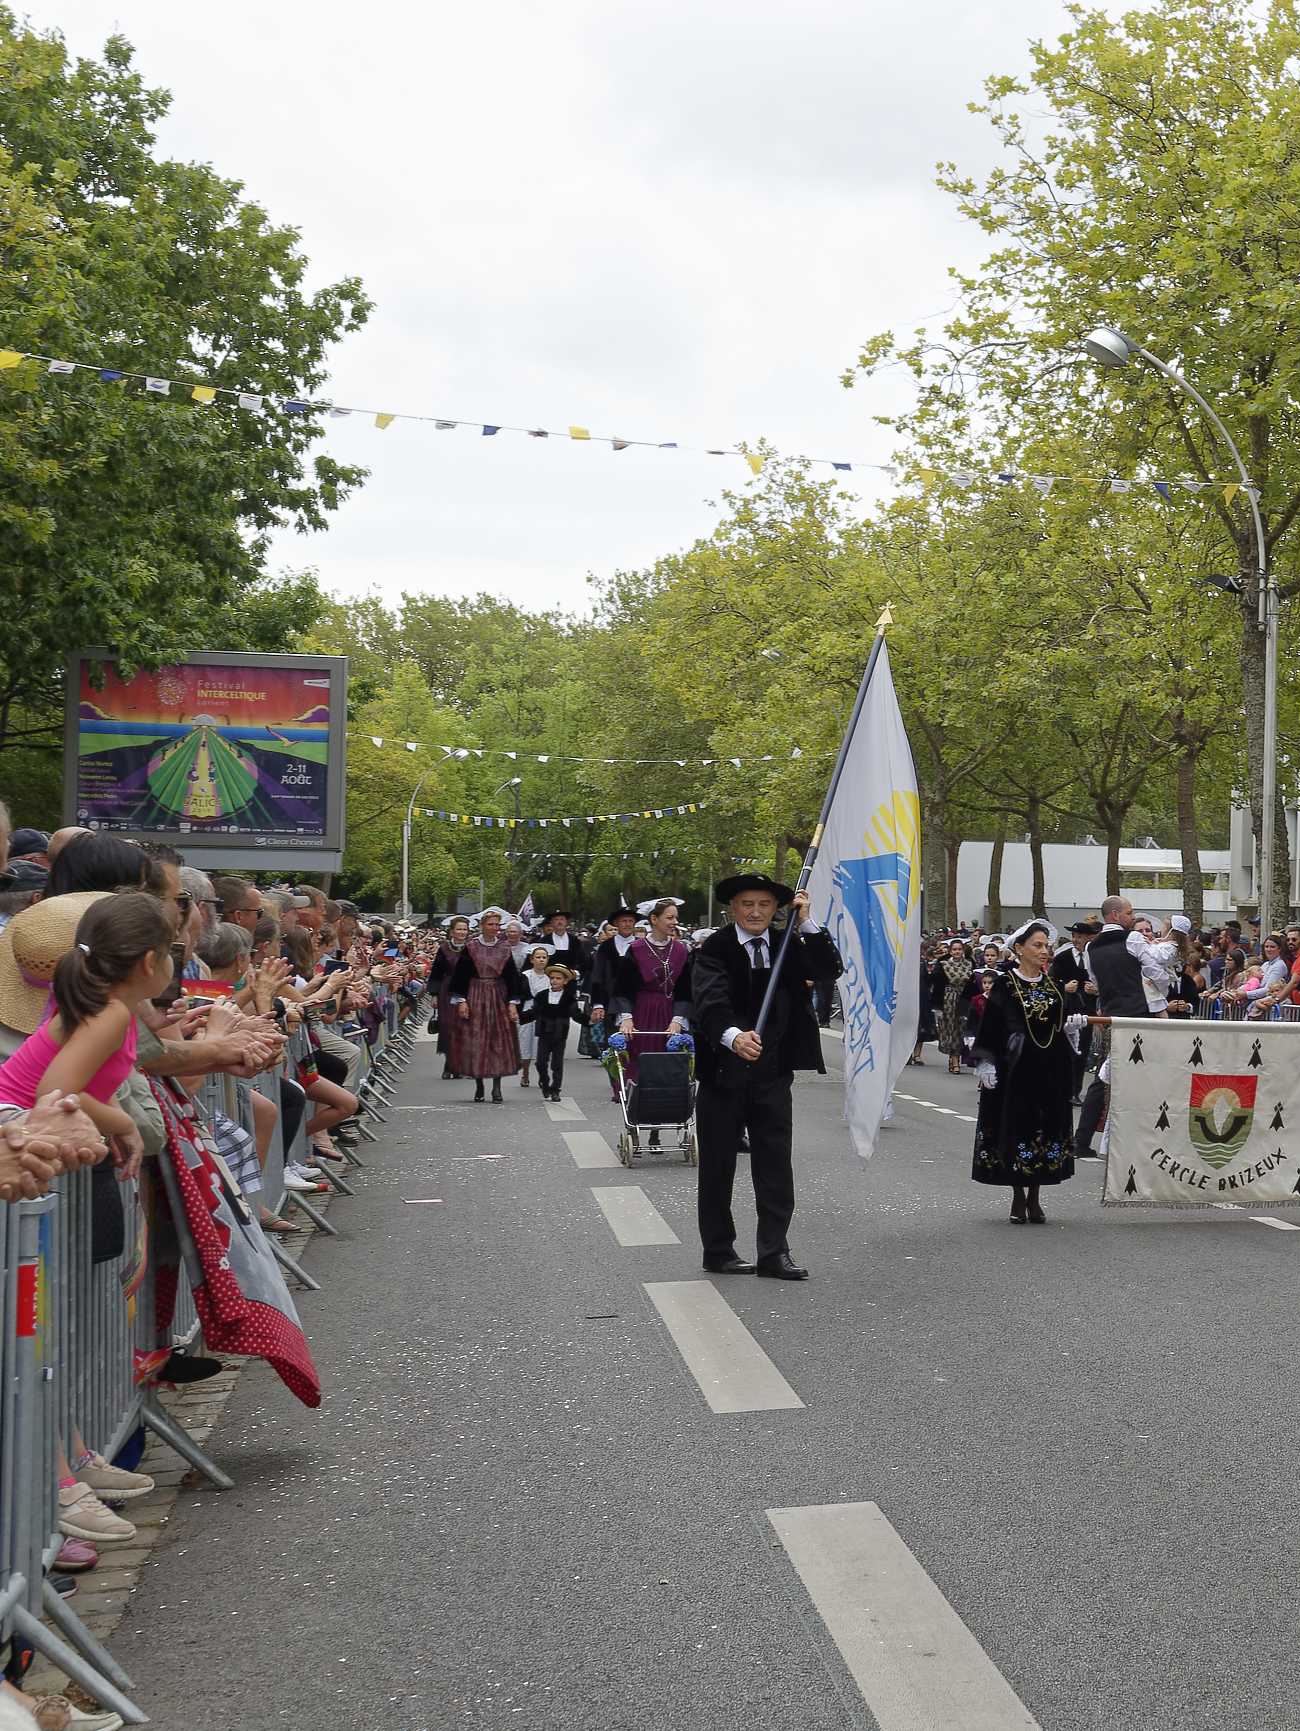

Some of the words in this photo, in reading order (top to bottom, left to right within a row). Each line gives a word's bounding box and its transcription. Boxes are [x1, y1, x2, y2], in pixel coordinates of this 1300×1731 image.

[197, 679, 246, 690] Festival
[197, 690, 267, 702] INTERCELTIQUE
[286, 764, 307, 774] 2-11
[266, 838, 290, 847] Clear
[290, 838, 323, 848] Channel
[1150, 1147, 1211, 1190] CERCLE
